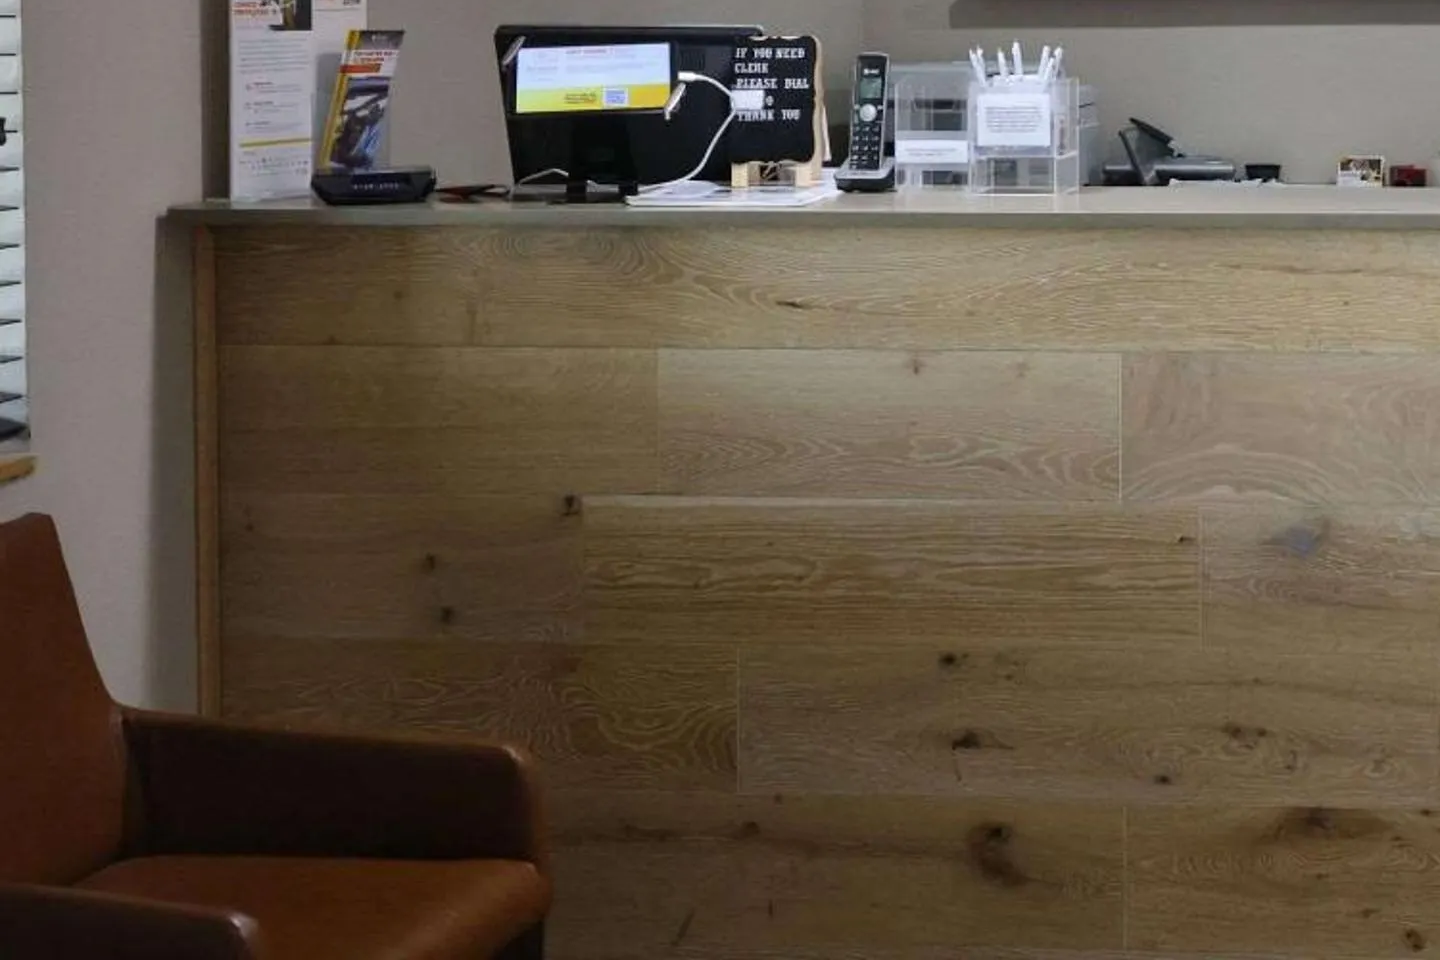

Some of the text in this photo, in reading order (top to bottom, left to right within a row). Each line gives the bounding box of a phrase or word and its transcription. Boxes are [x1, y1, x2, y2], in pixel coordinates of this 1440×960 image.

[734, 47, 806, 59] IF YOU NEED
[734, 62, 769, 74] CLERK
[736, 77, 810, 89] PLEASE DIAL
[736, 108, 802, 122] THANK YOU
